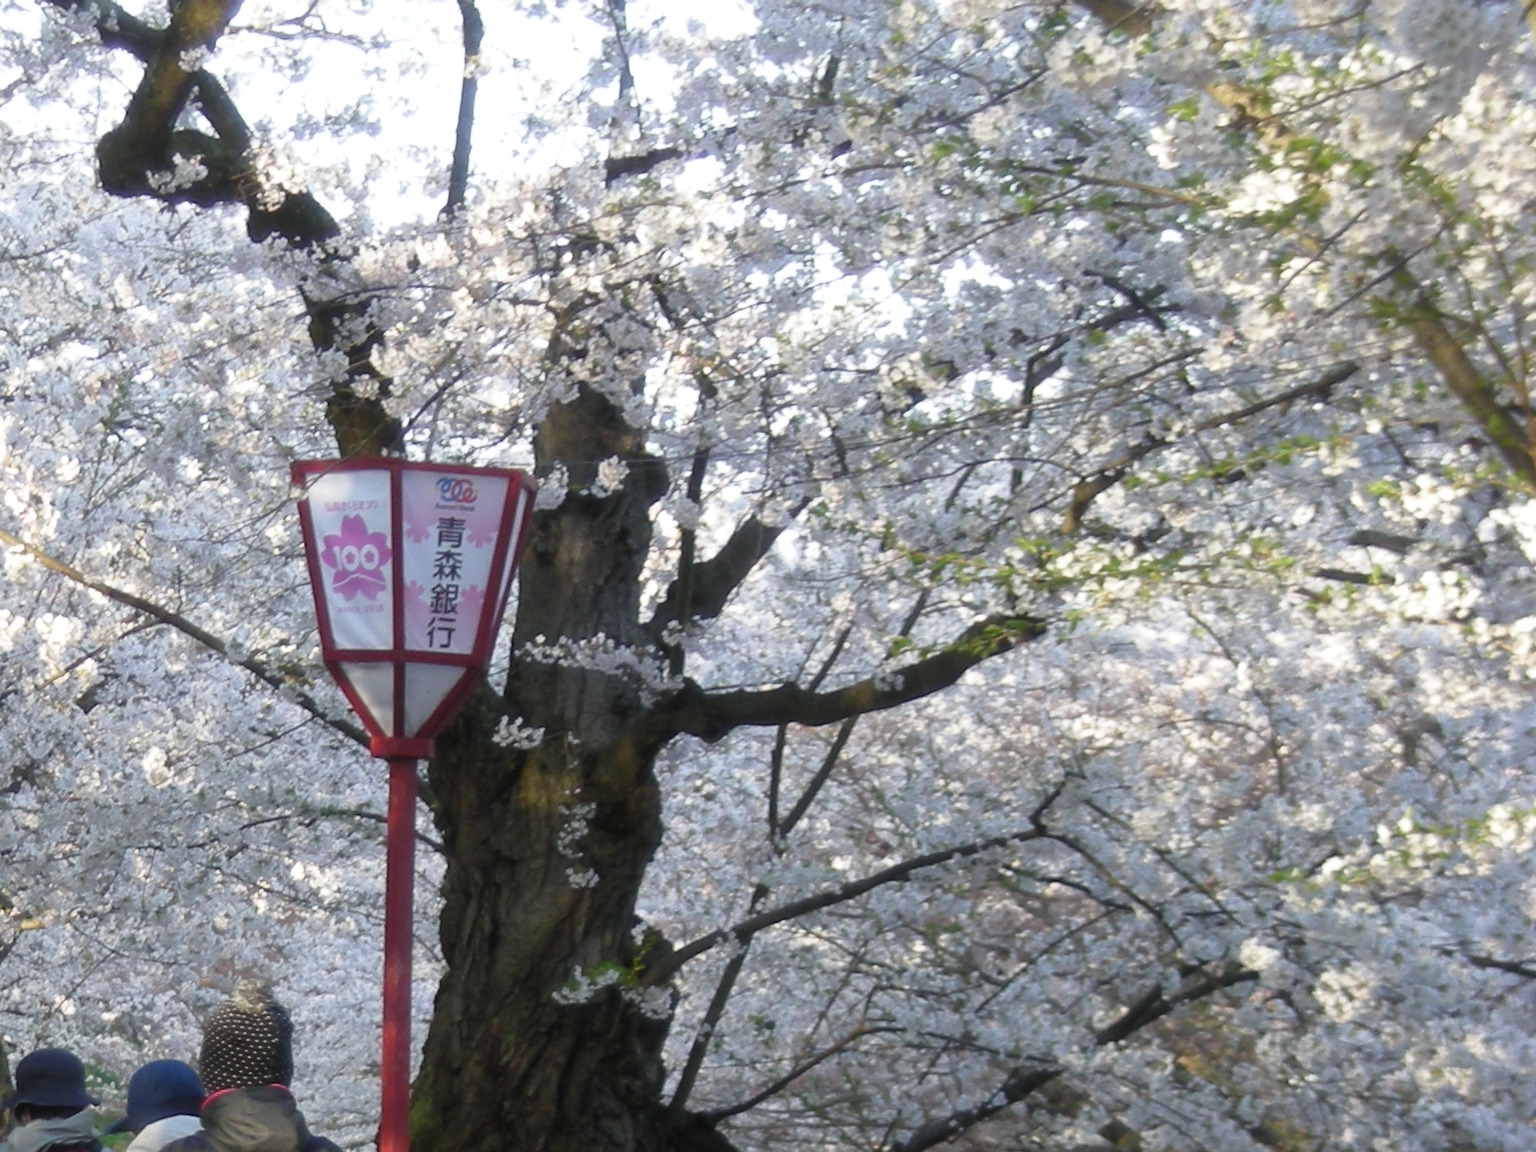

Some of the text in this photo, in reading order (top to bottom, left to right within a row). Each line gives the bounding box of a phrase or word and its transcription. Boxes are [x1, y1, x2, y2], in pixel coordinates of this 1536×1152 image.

[332, 543, 380, 571] 100
[427, 516, 467, 648] 青森銀行
